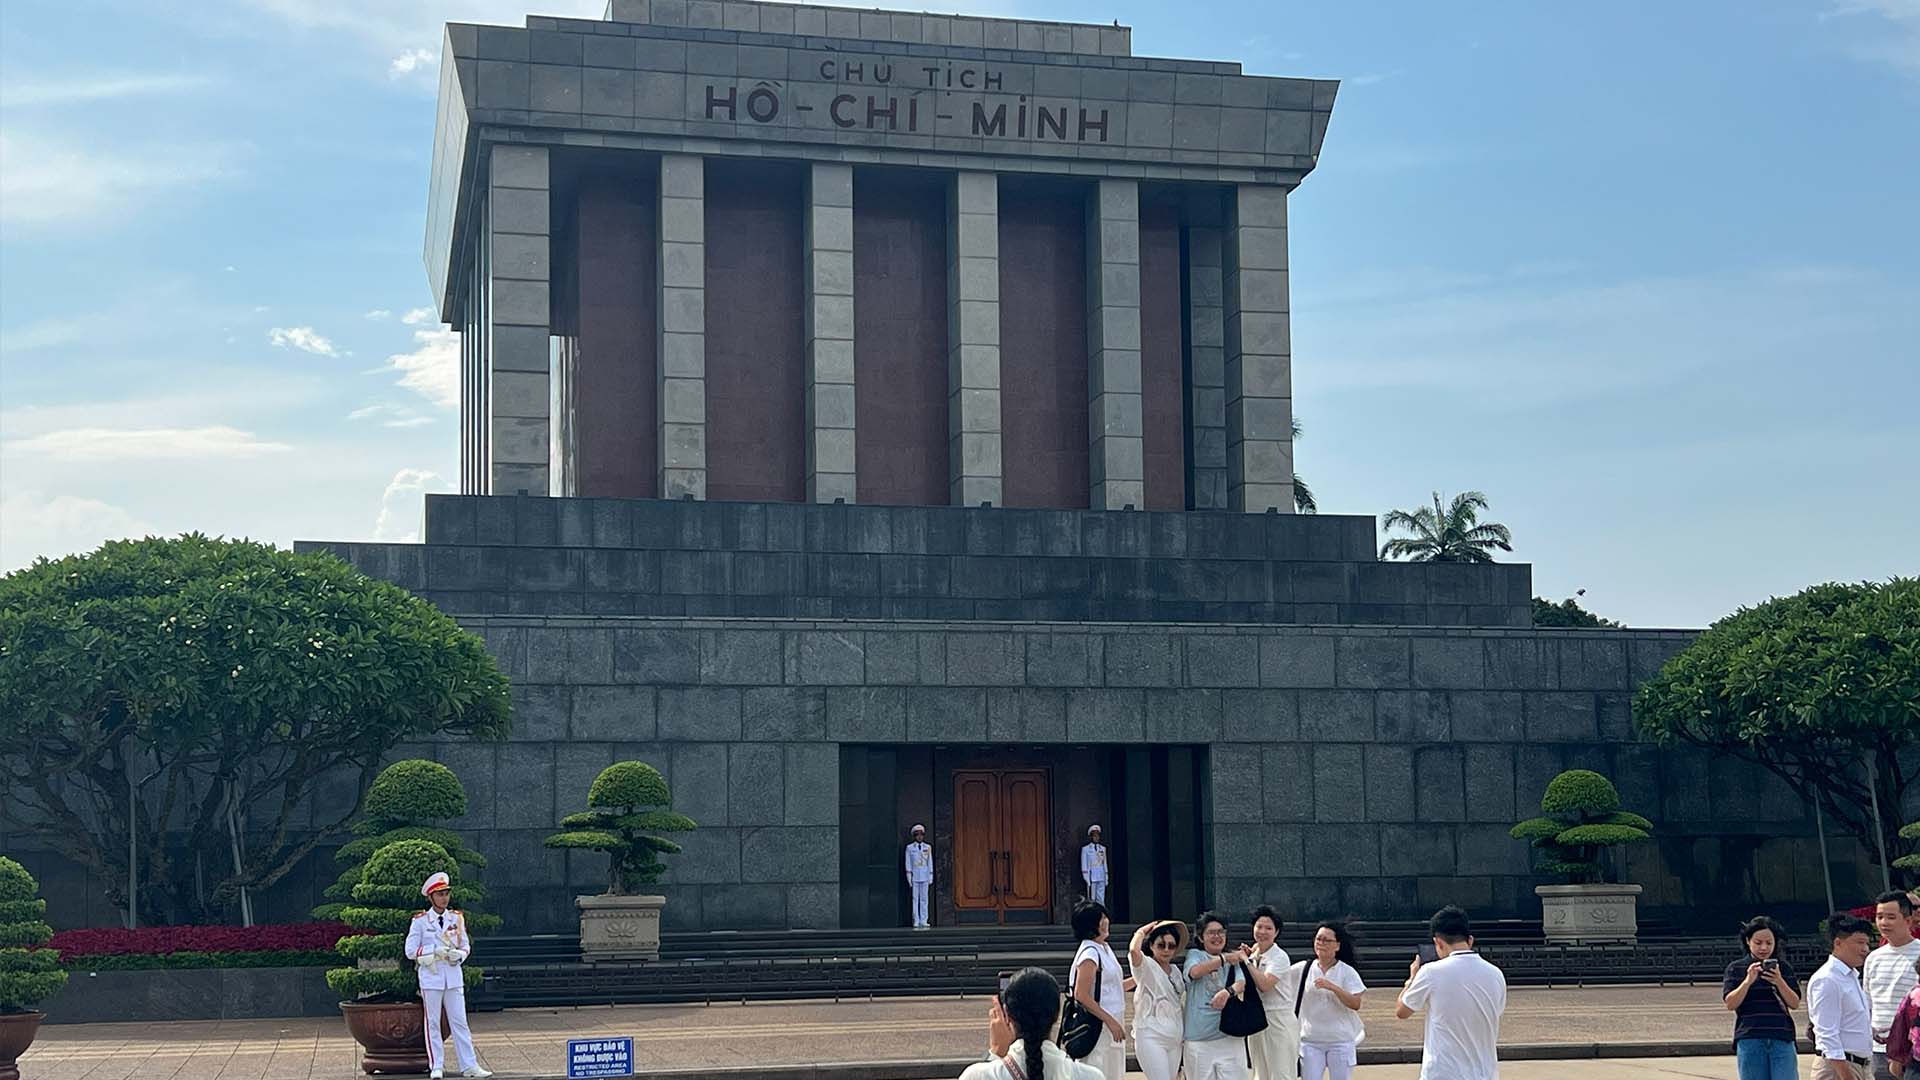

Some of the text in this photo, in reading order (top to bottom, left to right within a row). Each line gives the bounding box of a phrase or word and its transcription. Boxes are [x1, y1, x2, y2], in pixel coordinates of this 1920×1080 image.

[705, 80, 782, 123] HỒ
[830, 90, 922, 132] CHÍ
[575, 1044, 588, 1052] KHU
[603, 1041, 616, 1050] BẢO
[574, 1053, 595, 1063] KHÔNG
[615, 1052, 627, 1061] VÀO
